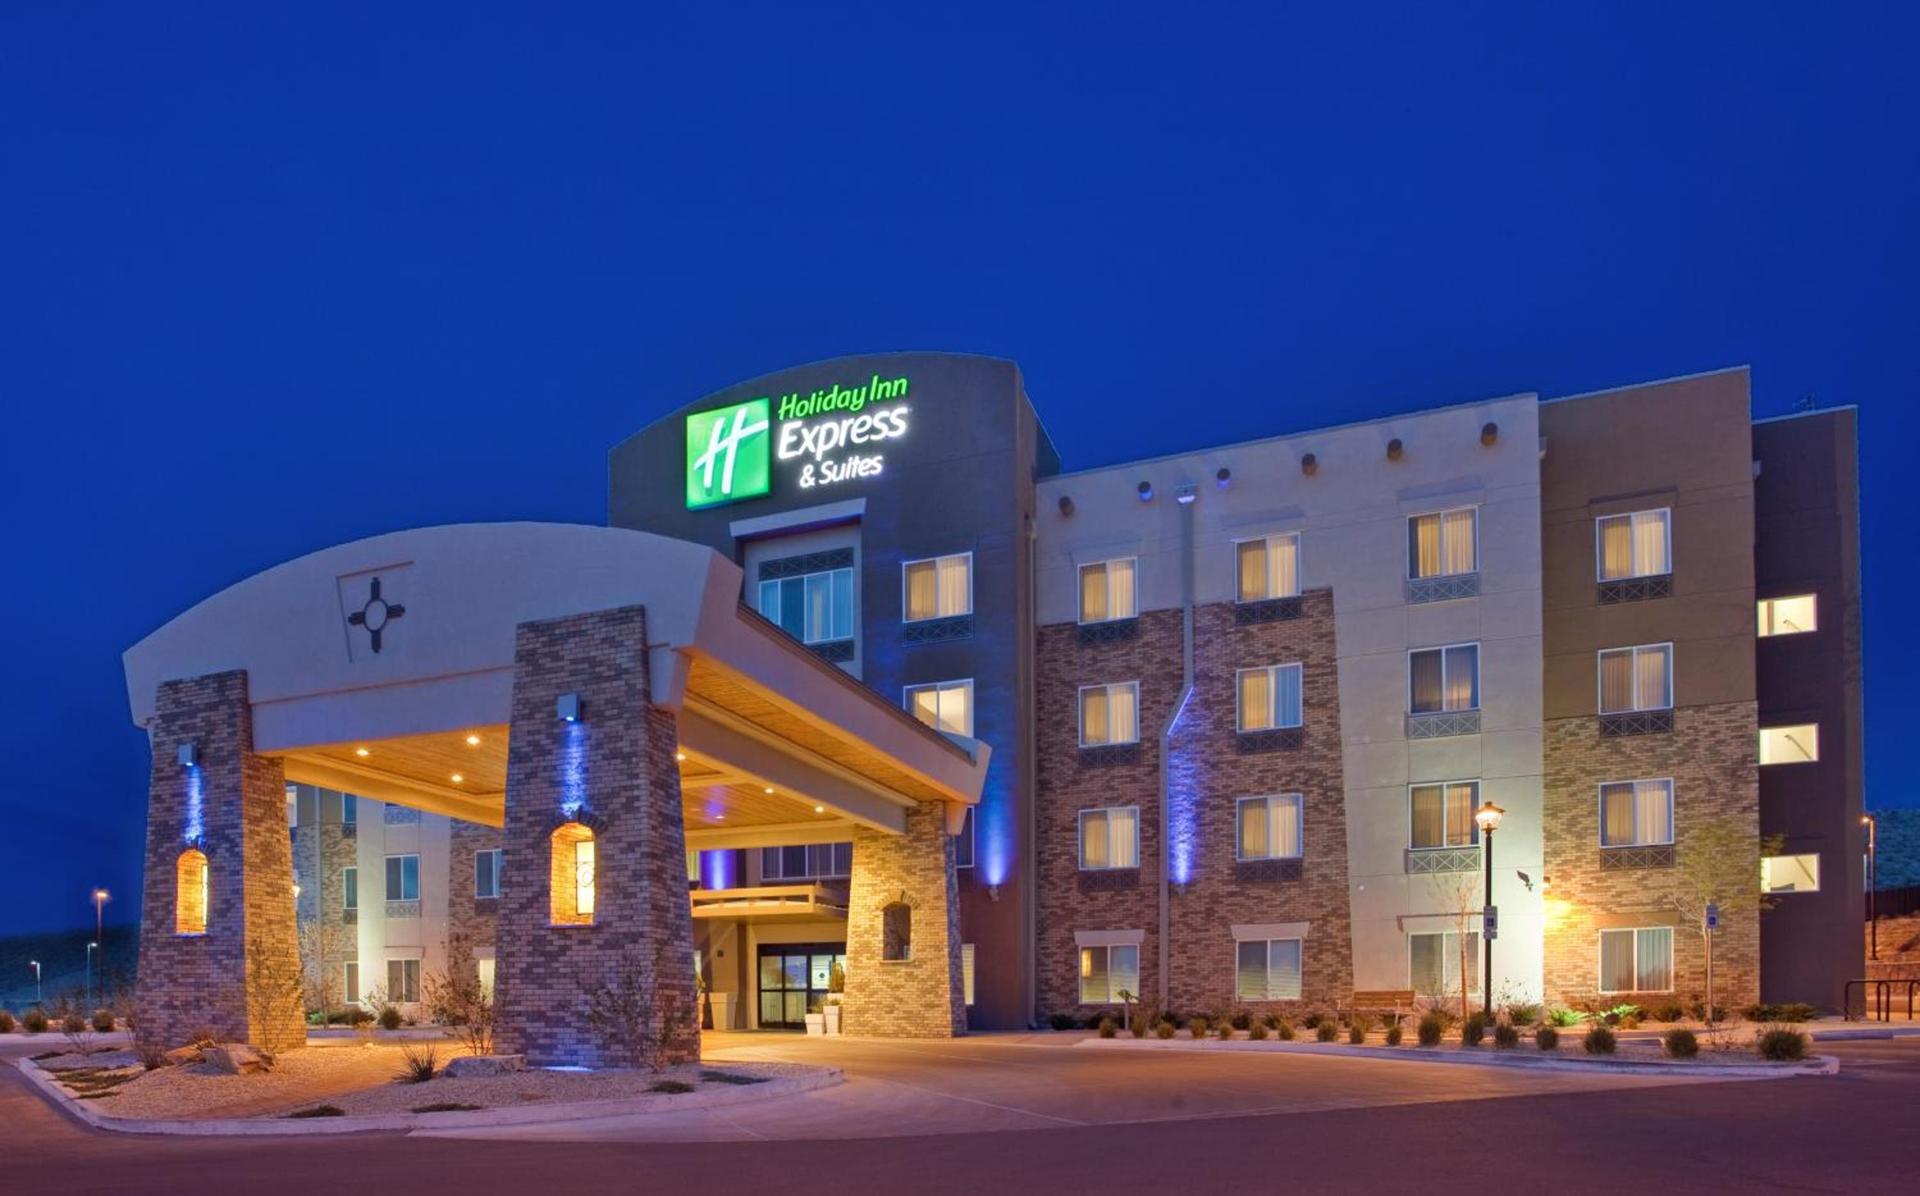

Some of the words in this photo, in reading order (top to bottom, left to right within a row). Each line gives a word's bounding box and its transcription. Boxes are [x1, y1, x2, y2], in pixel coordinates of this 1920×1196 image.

[778, 384, 867, 420] Holiday
[869, 374, 908, 401] Inn
[777, 406, 909, 461] Express
[799, 463, 816, 488] &
[818, 455, 884, 485] Suites
